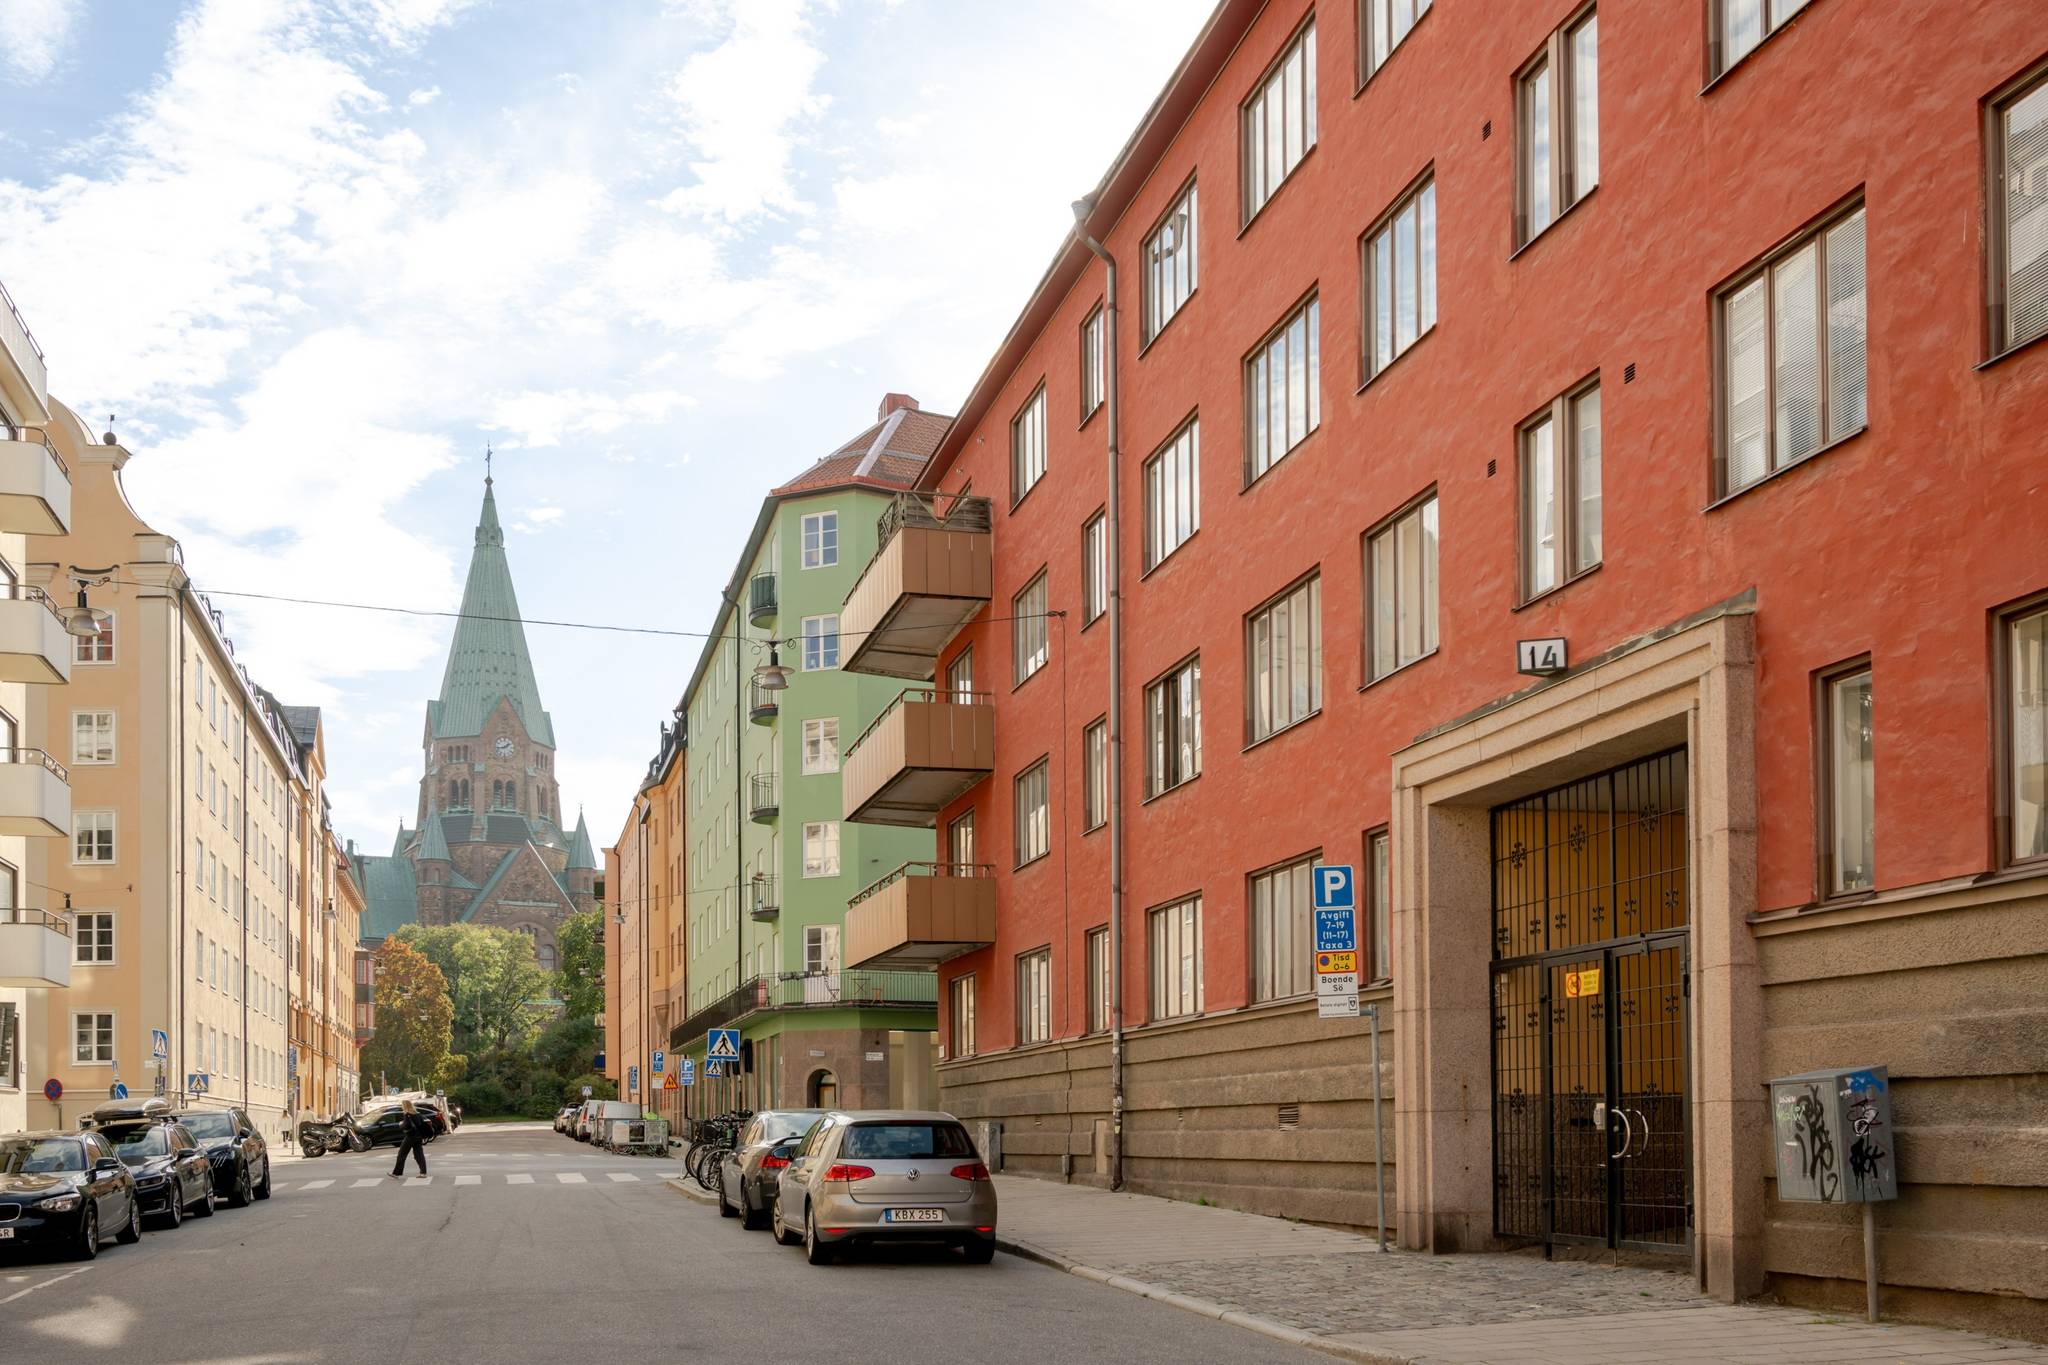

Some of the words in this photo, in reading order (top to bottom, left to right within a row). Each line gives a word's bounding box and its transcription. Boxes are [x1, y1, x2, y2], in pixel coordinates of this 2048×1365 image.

[1529, 645, 1557, 670] 14
[1324, 870, 1346, 904] P
[1320, 911, 1350, 921] Avgift
[1325, 921, 1345, 929] 7-19
[1322, 930, 1349, 940] (11-17)
[1320, 941, 1343, 949] Taxa
[1346, 940, 1353, 949] 3
[1333, 953, 1350, 961] Tisd
[1333, 962, 1350, 970] 0-6
[1321, 976, 1353, 984] Boende
[1332, 984, 1344, 992] Sö
[655, 1052, 663, 1061] P
[684, 1060, 692, 1071] P
[895, 1210, 915, 1220] KBX
[918, 1210, 938, 1220] 255
